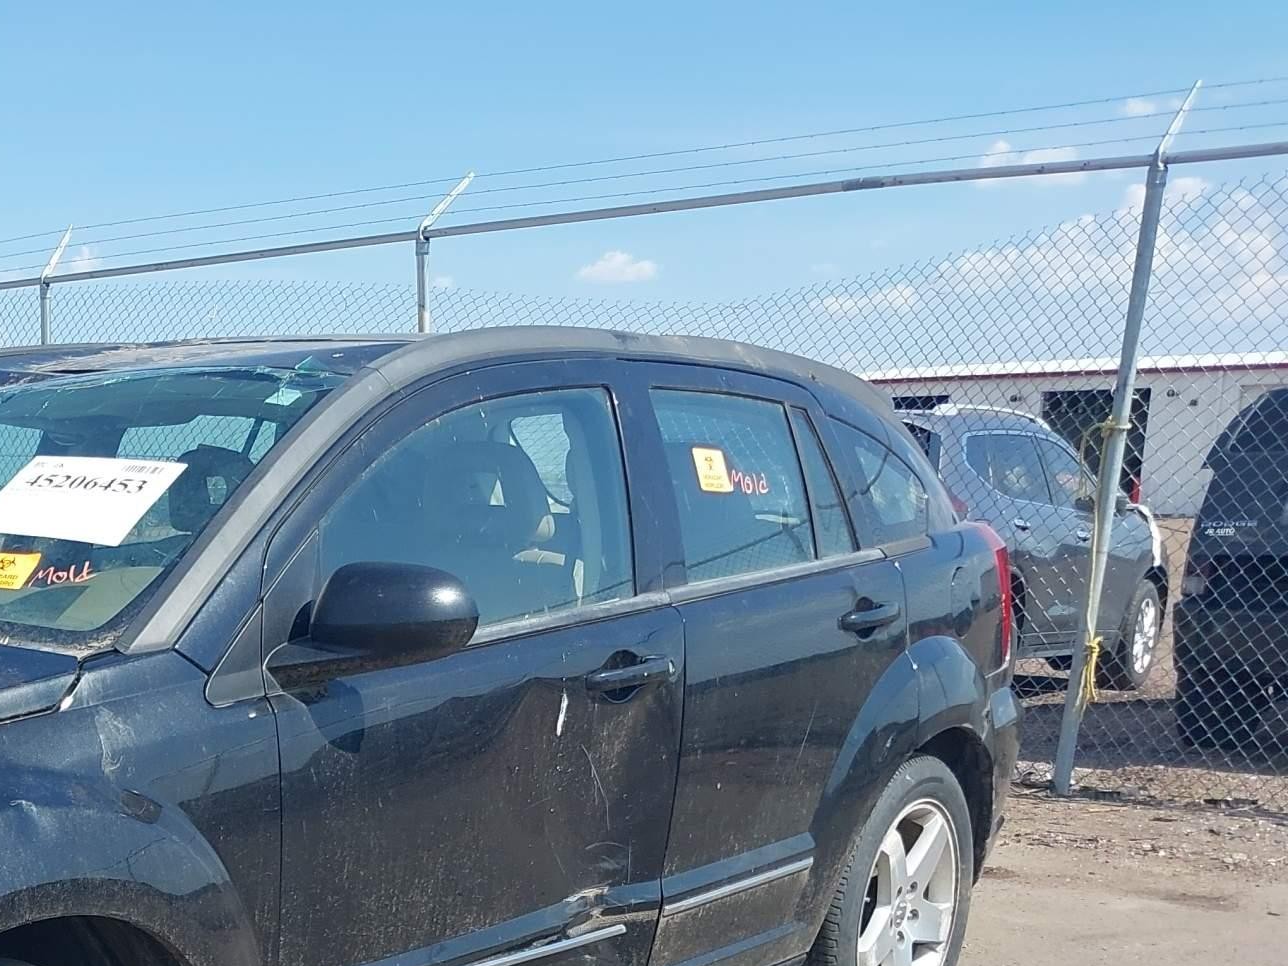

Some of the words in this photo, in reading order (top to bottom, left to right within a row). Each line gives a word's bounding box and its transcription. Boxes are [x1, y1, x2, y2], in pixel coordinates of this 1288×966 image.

[25, 473, 148, 494] 45206453
[731, 469, 769, 496] Mold
[28, 560, 97, 588] Mold
